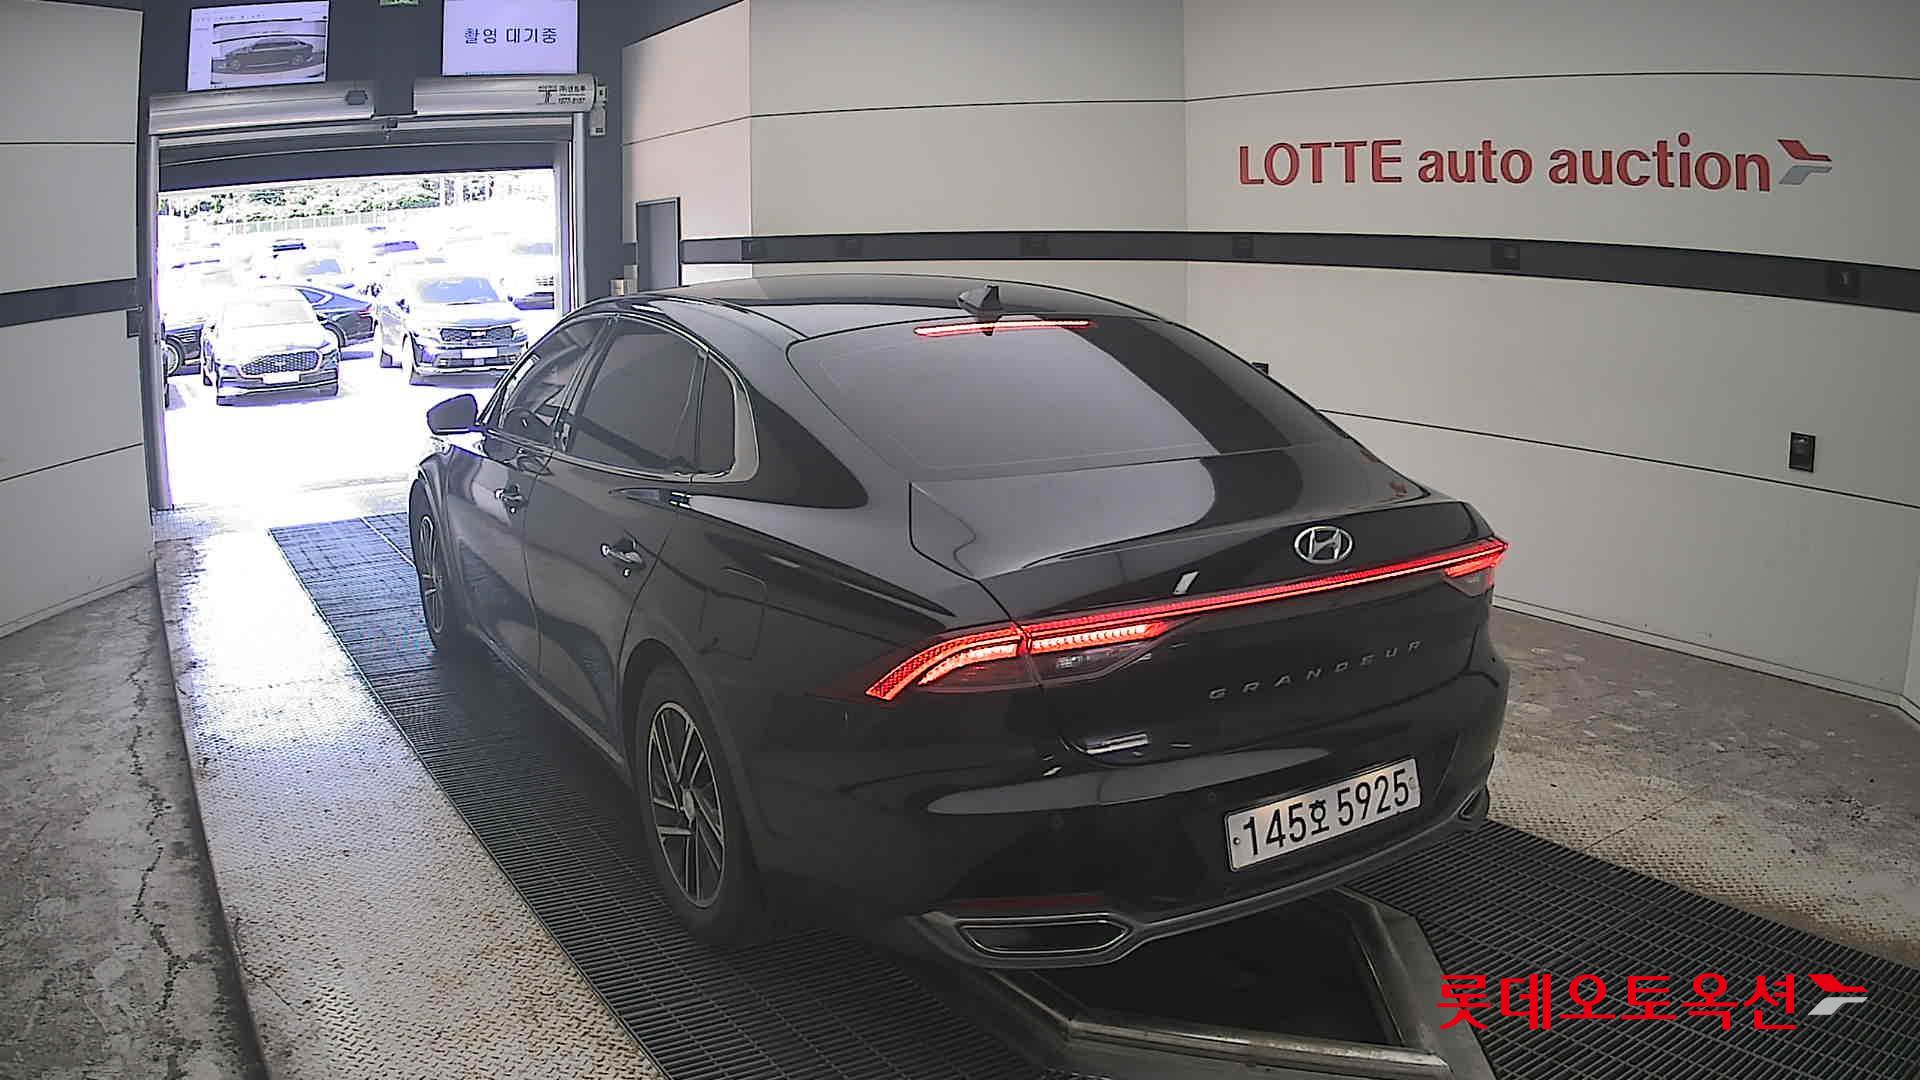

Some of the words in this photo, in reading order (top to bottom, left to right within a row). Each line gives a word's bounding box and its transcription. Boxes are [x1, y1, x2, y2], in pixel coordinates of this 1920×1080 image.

[464, 27, 497, 44] 촬영
[506, 27, 558, 44] 대기중
[1239, 139, 1402, 186] LOTTE
[1417, 139, 1533, 185] auto
[1548, 132, 1771, 192] auction
[1208, 640, 1421, 699] GRANDEUR
[1242, 799, 1330, 856] 145호
[1337, 768, 1409, 826] 5925
